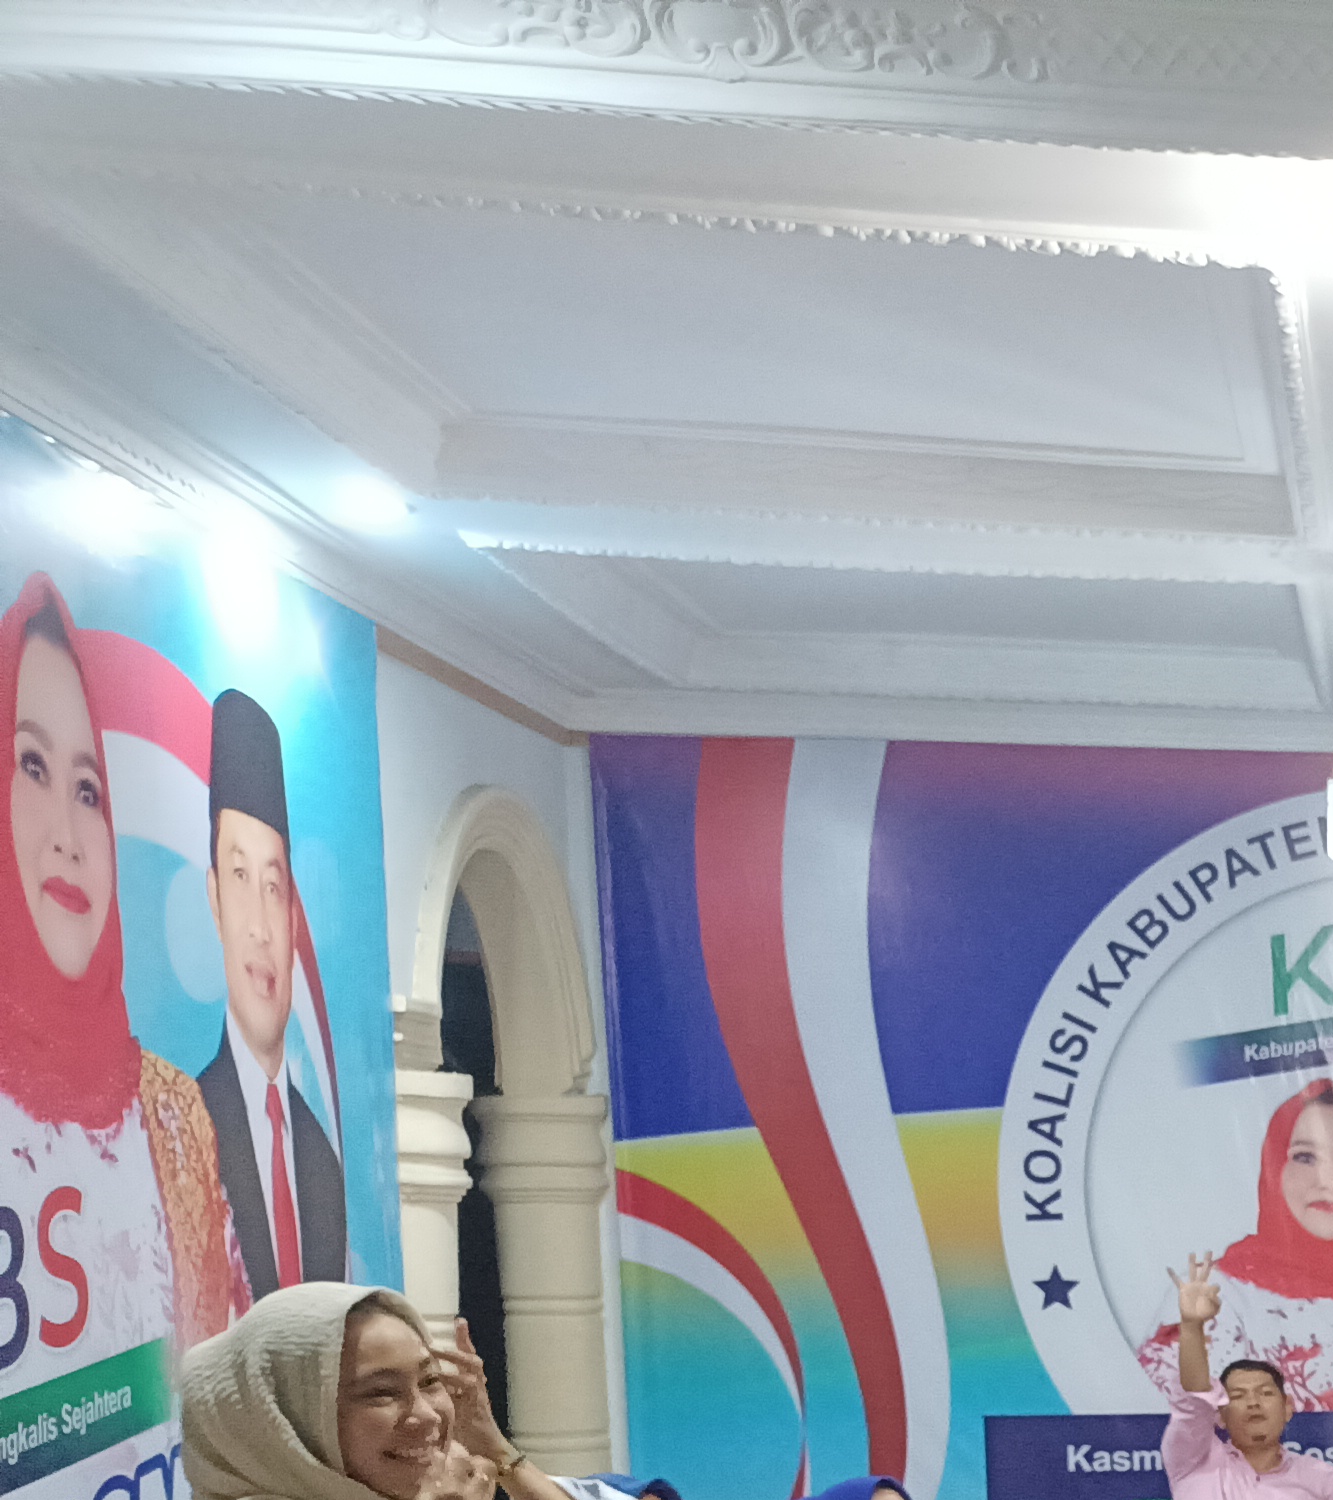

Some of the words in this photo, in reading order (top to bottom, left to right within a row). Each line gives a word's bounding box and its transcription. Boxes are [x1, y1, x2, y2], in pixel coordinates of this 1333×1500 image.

[1022, 1011, 1099, 1222] KOALISI
[1076, 815, 1329, 1009] KABUPATE
[61, 1385, 133, 1436] Sejahtera
